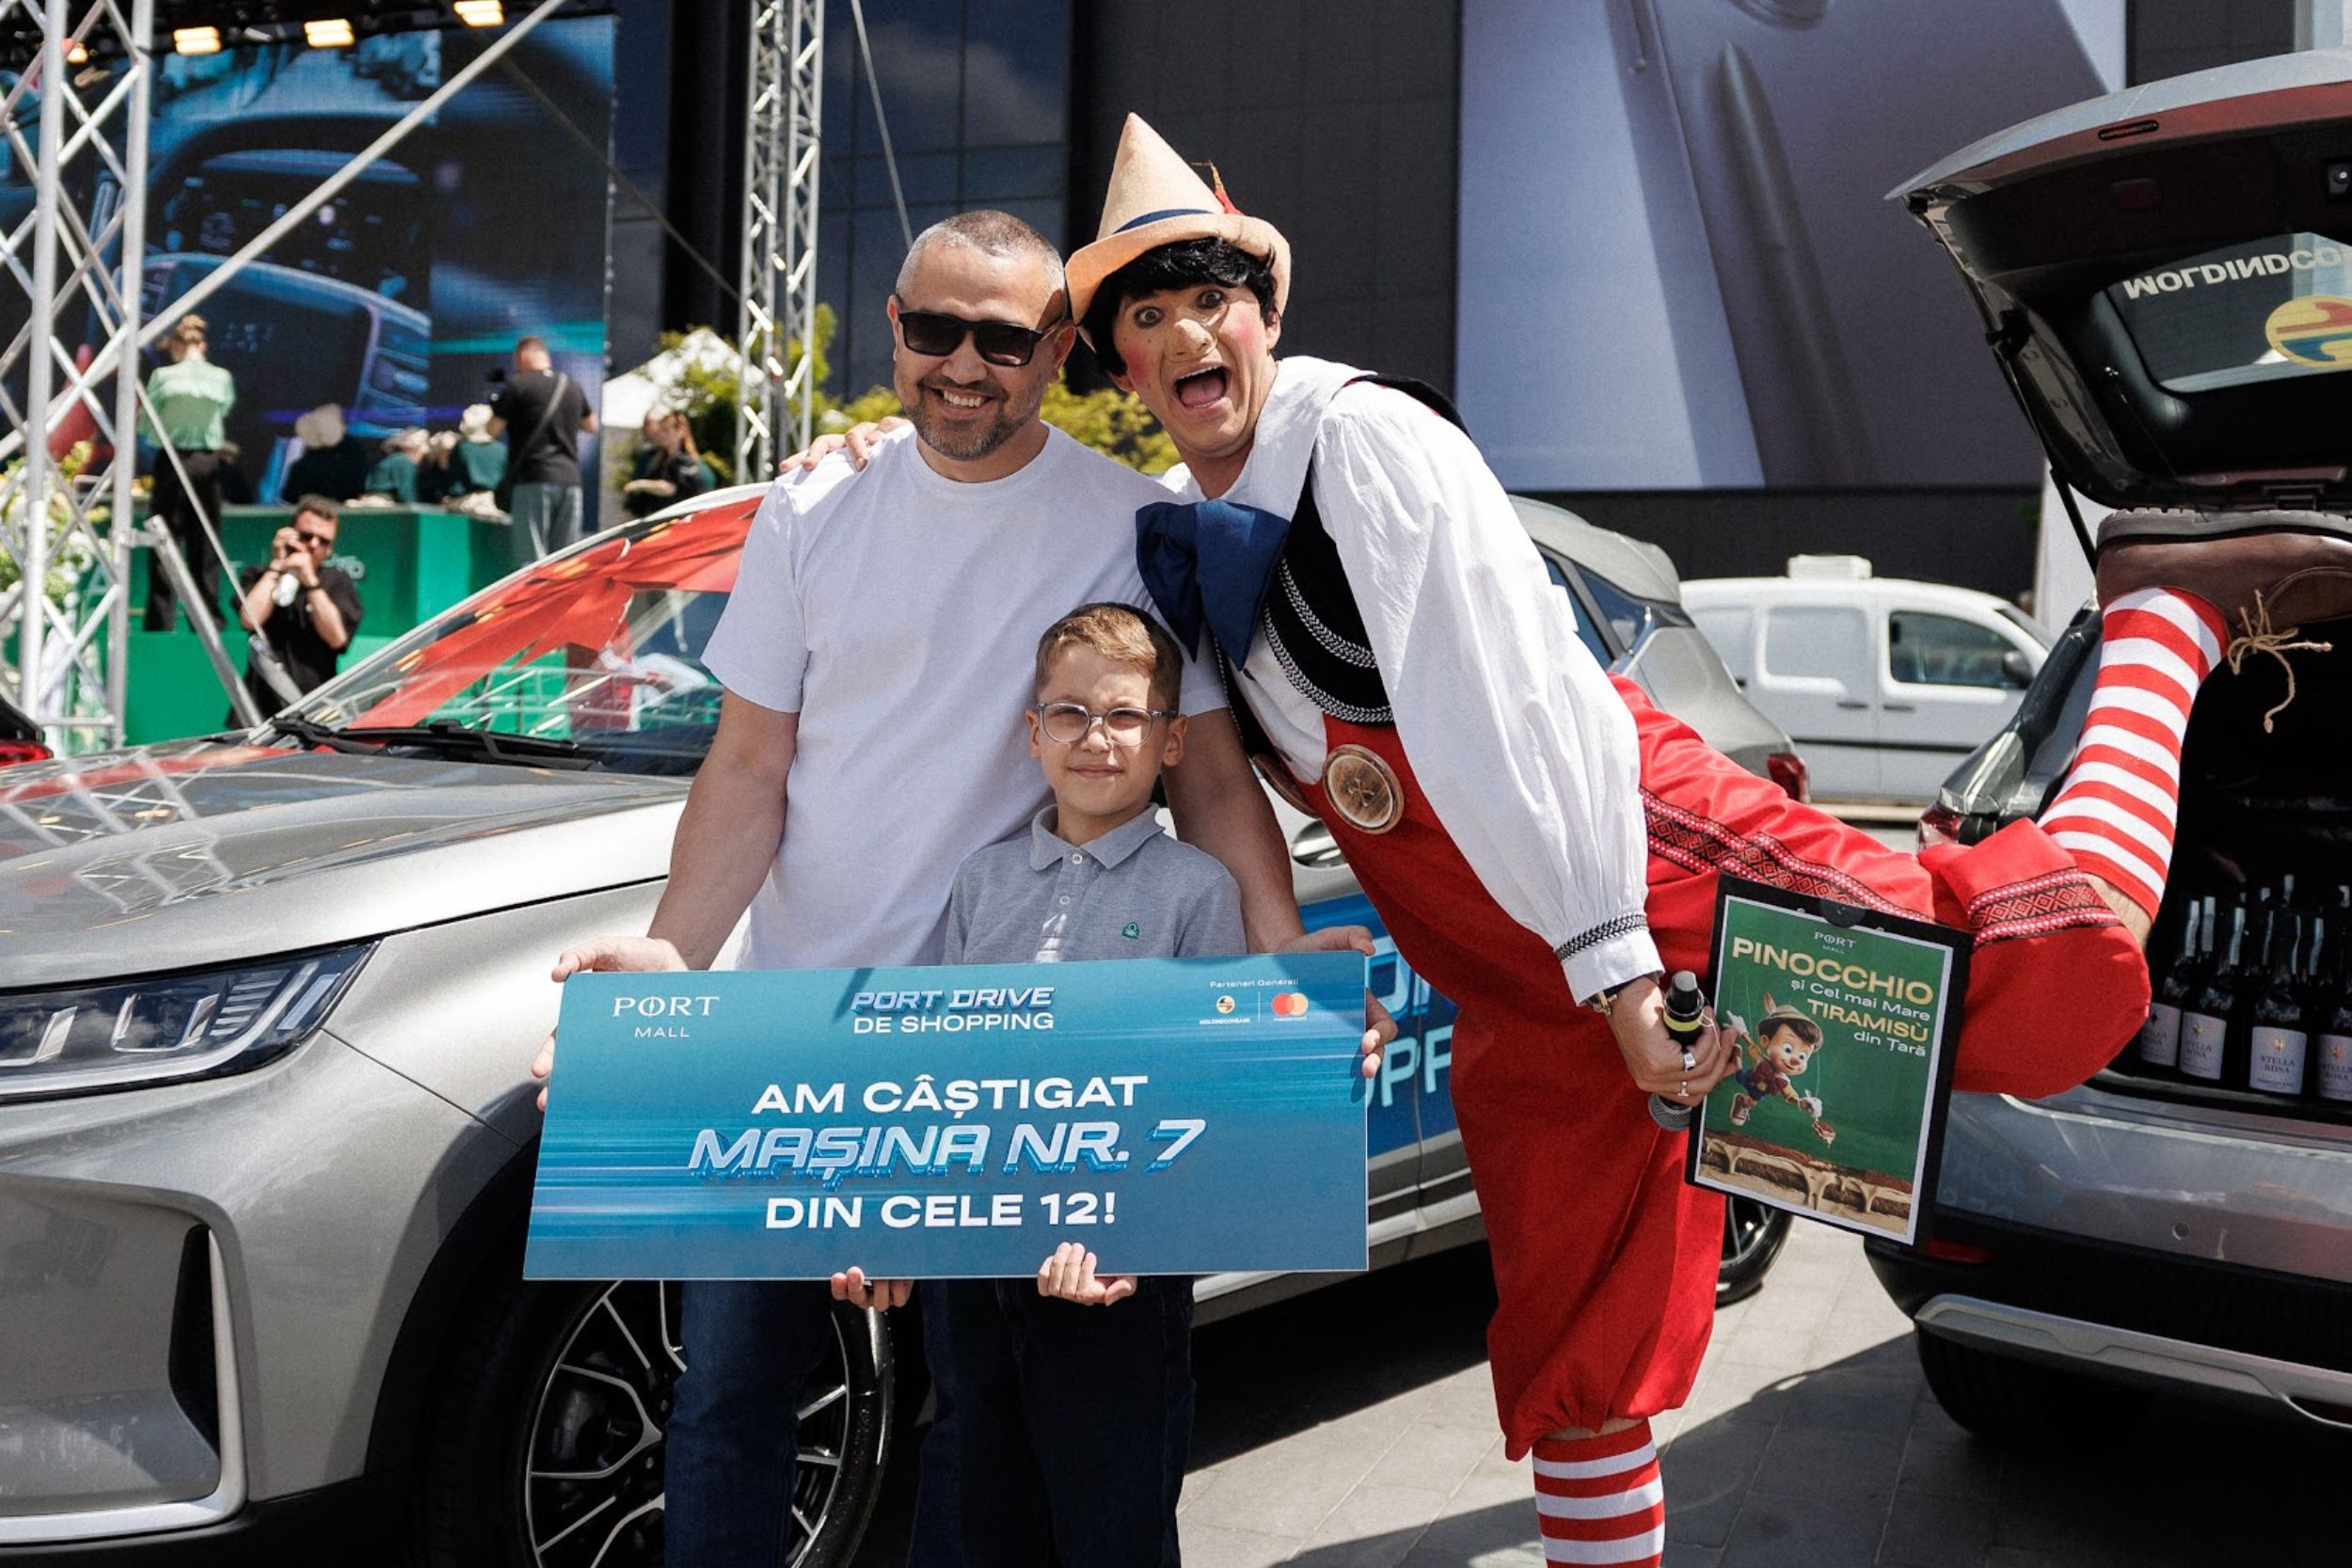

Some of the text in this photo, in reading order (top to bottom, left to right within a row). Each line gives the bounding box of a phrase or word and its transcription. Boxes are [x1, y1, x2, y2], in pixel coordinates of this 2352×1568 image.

[1814, 931, 1857, 948] PORT
[1210, 978, 1299, 989] Parteneri Generali
[1732, 936, 1933, 1005] PINOCCHIO
[612, 994, 721, 1018] PORT
[850, 987, 1055, 1014] PORT DRIVE
[1809, 982, 1840, 999] Cel
[1845, 993, 1878, 1009] mai
[1883, 1001, 1931, 1022] Mare
[634, 1026, 691, 1038] MALL
[853, 1012, 1055, 1035] DE SHOPPING
[1806, 998, 1929, 1042] TIRAMISÙ
[1853, 1031, 1926, 1057] din Țară
[2261, 1055, 2296, 1068] STELLA
[751, 1074, 1149, 1119] AM CÂȘTIGAT
[688, 1119, 1206, 1191] MAȘINA NR. 7
[765, 1192, 1116, 1229] DIN CELE 12!
